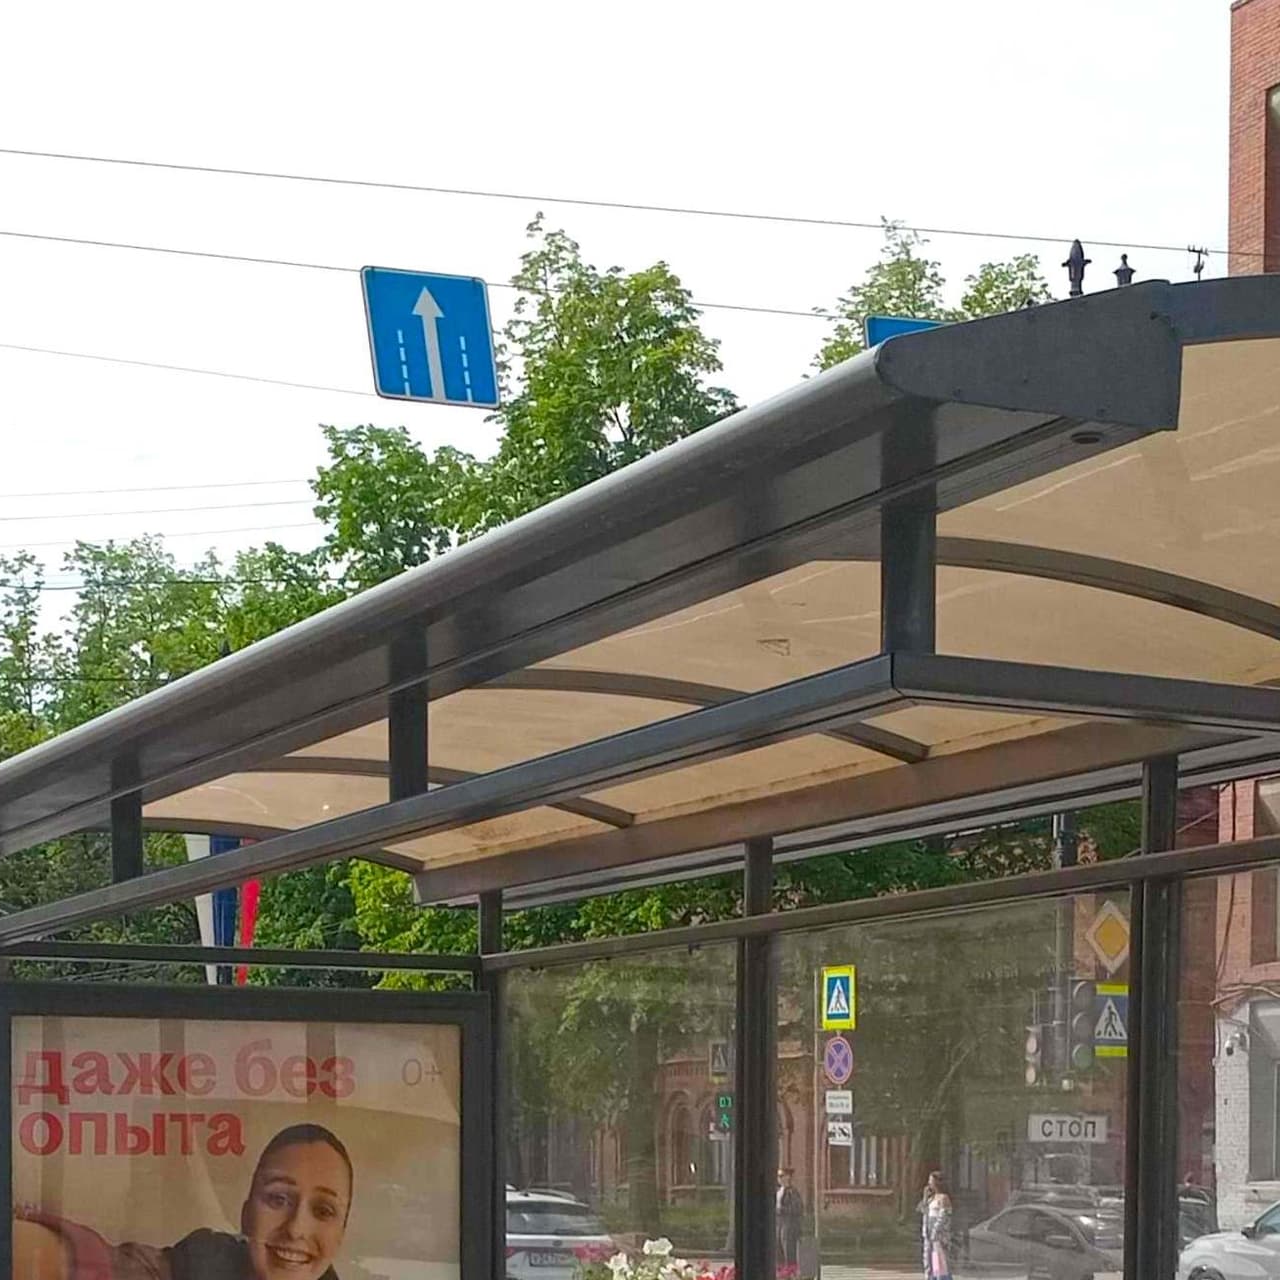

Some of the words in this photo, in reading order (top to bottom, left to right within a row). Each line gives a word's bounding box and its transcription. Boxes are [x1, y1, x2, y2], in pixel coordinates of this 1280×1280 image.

[20, 1048, 217, 1105] даже
[233, 1038, 356, 1099] без
[401, 1057, 443, 1087] 0+
[20, 1110, 247, 1156] опыта
[1041, 1119, 1096, 1138] СТОП
